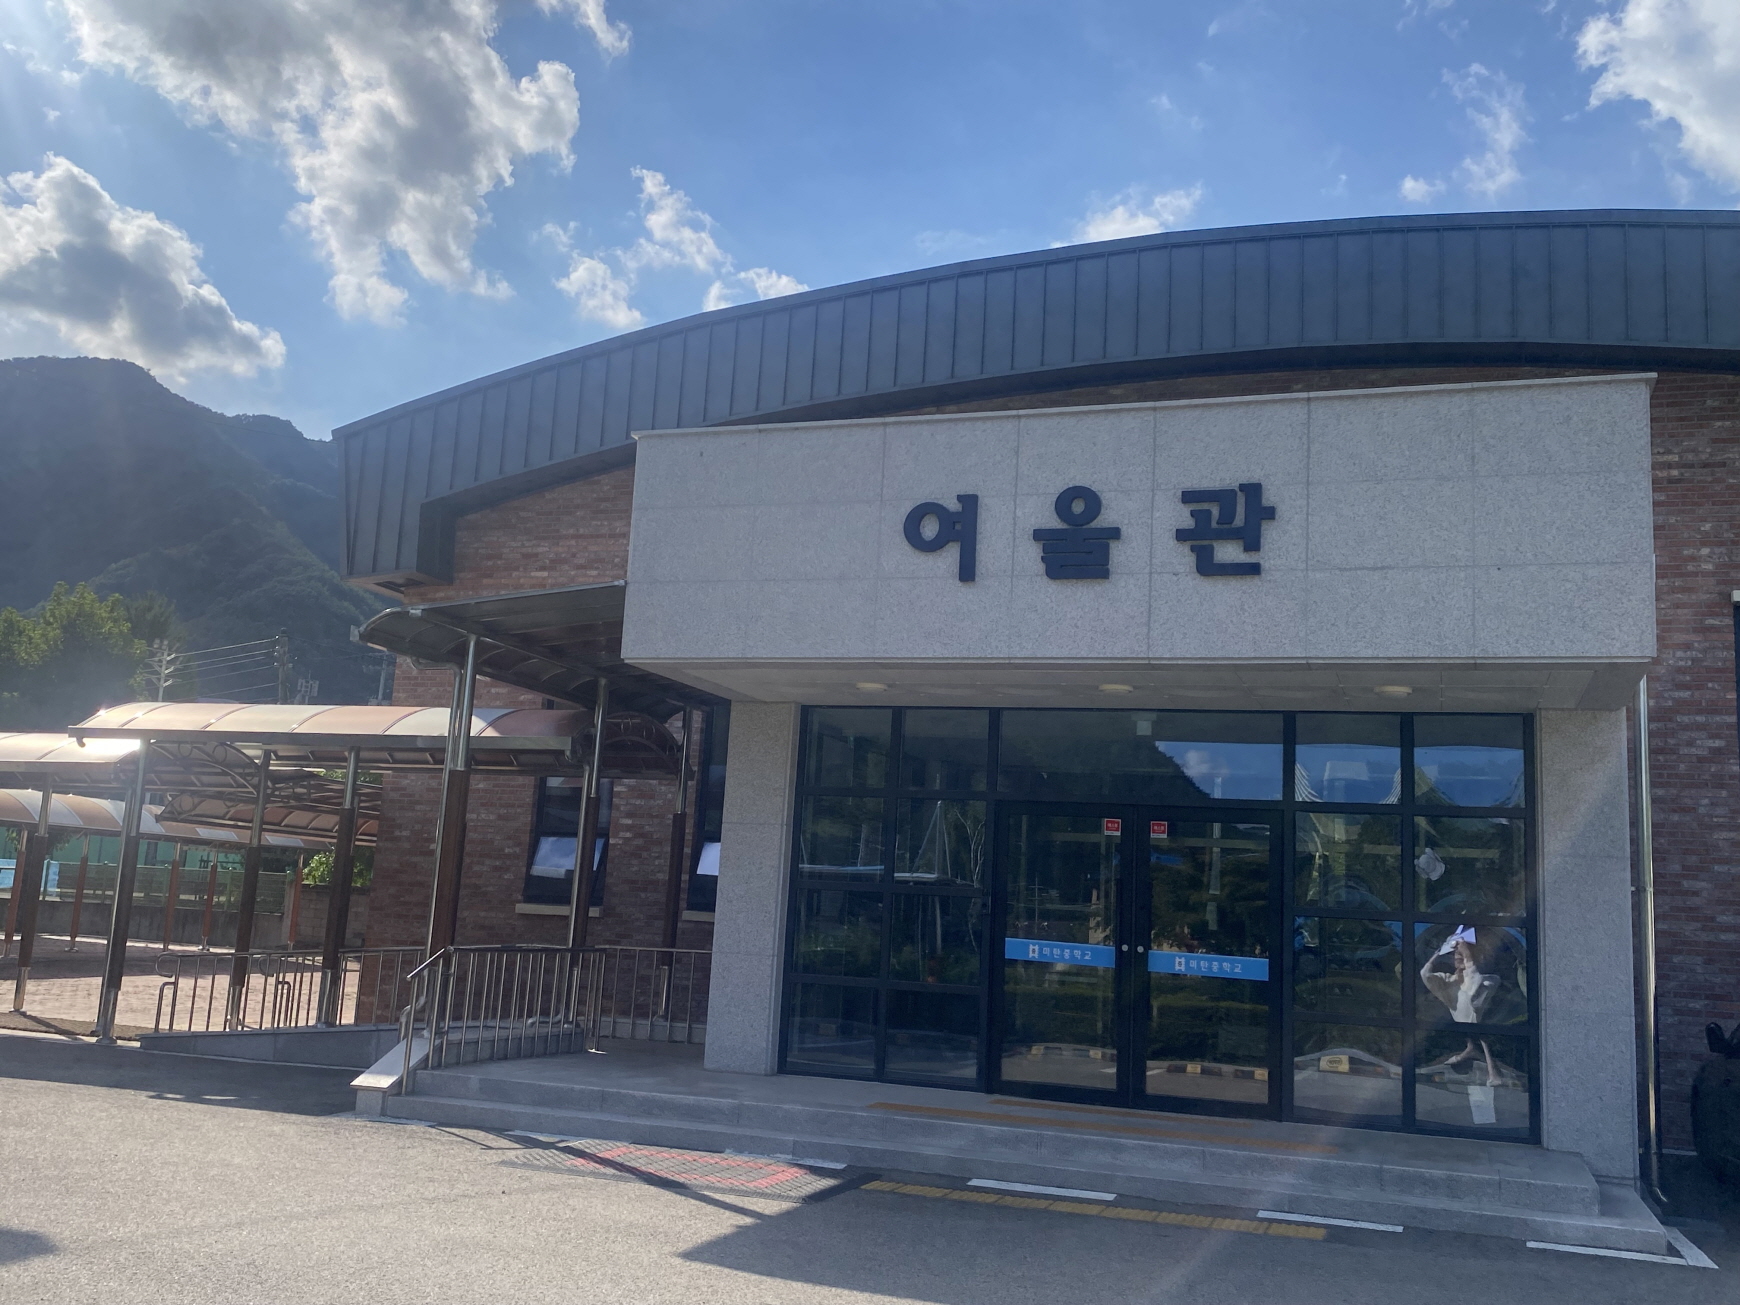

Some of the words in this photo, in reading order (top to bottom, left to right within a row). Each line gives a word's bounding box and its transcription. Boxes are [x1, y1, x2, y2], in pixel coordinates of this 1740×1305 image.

[903, 483, 1276, 582] 여울관
[1042, 946, 1092, 960] 미탄중학교
[1189, 959, 1242, 973] 미탄중학교
